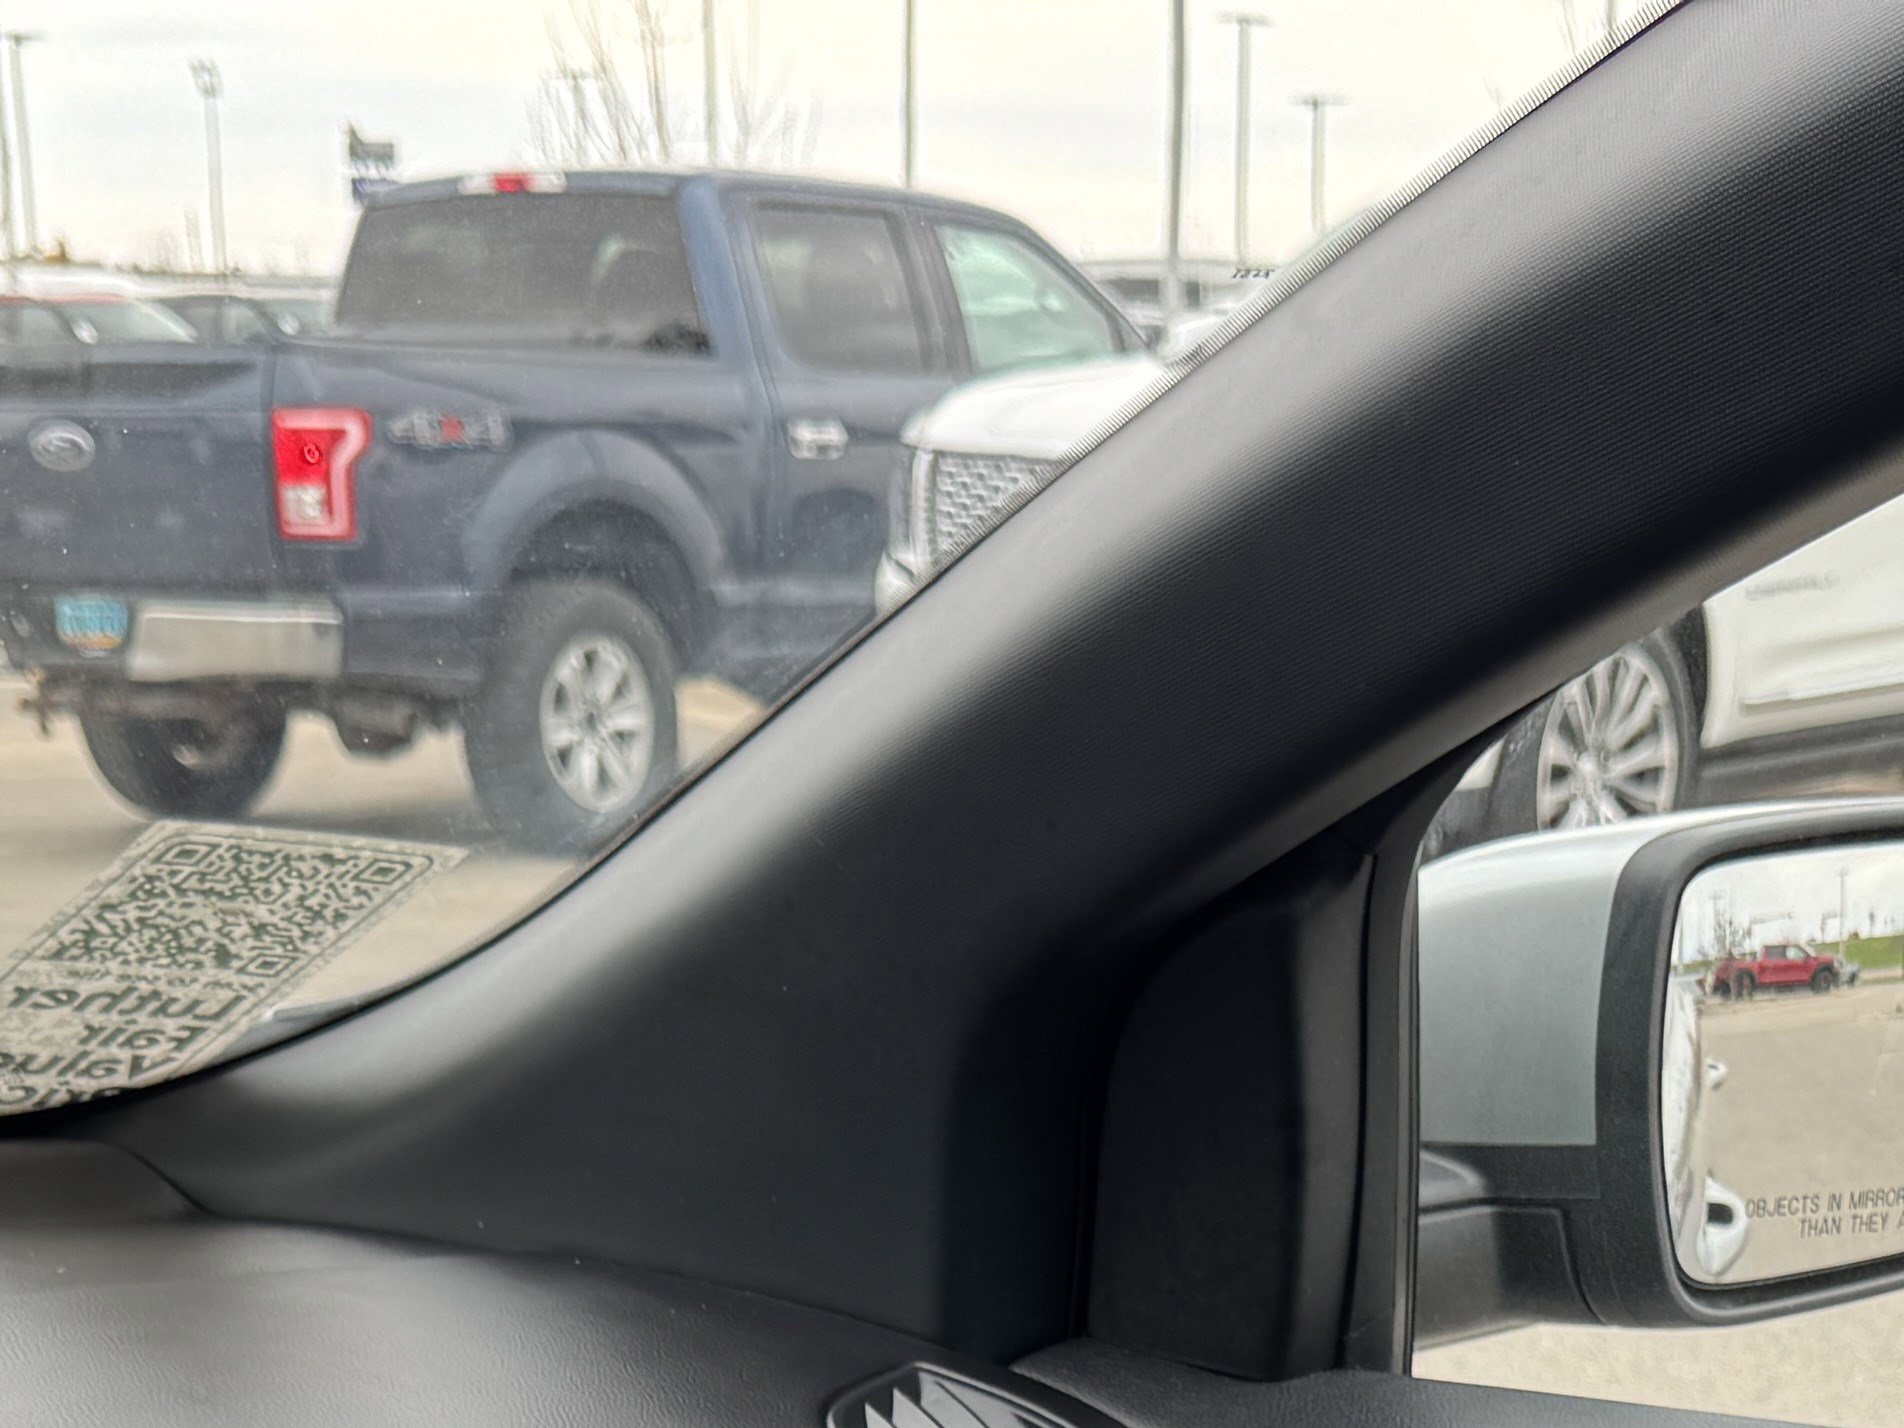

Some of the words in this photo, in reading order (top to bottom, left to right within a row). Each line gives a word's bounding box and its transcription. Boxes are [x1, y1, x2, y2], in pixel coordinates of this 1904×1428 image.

[1745, 1193, 1820, 1219] OBJECTS
[1826, 1191, 1842, 1212] IN
[1799, 1218, 1842, 1239] THAN
[1850, 1211, 1888, 1234] THEY
